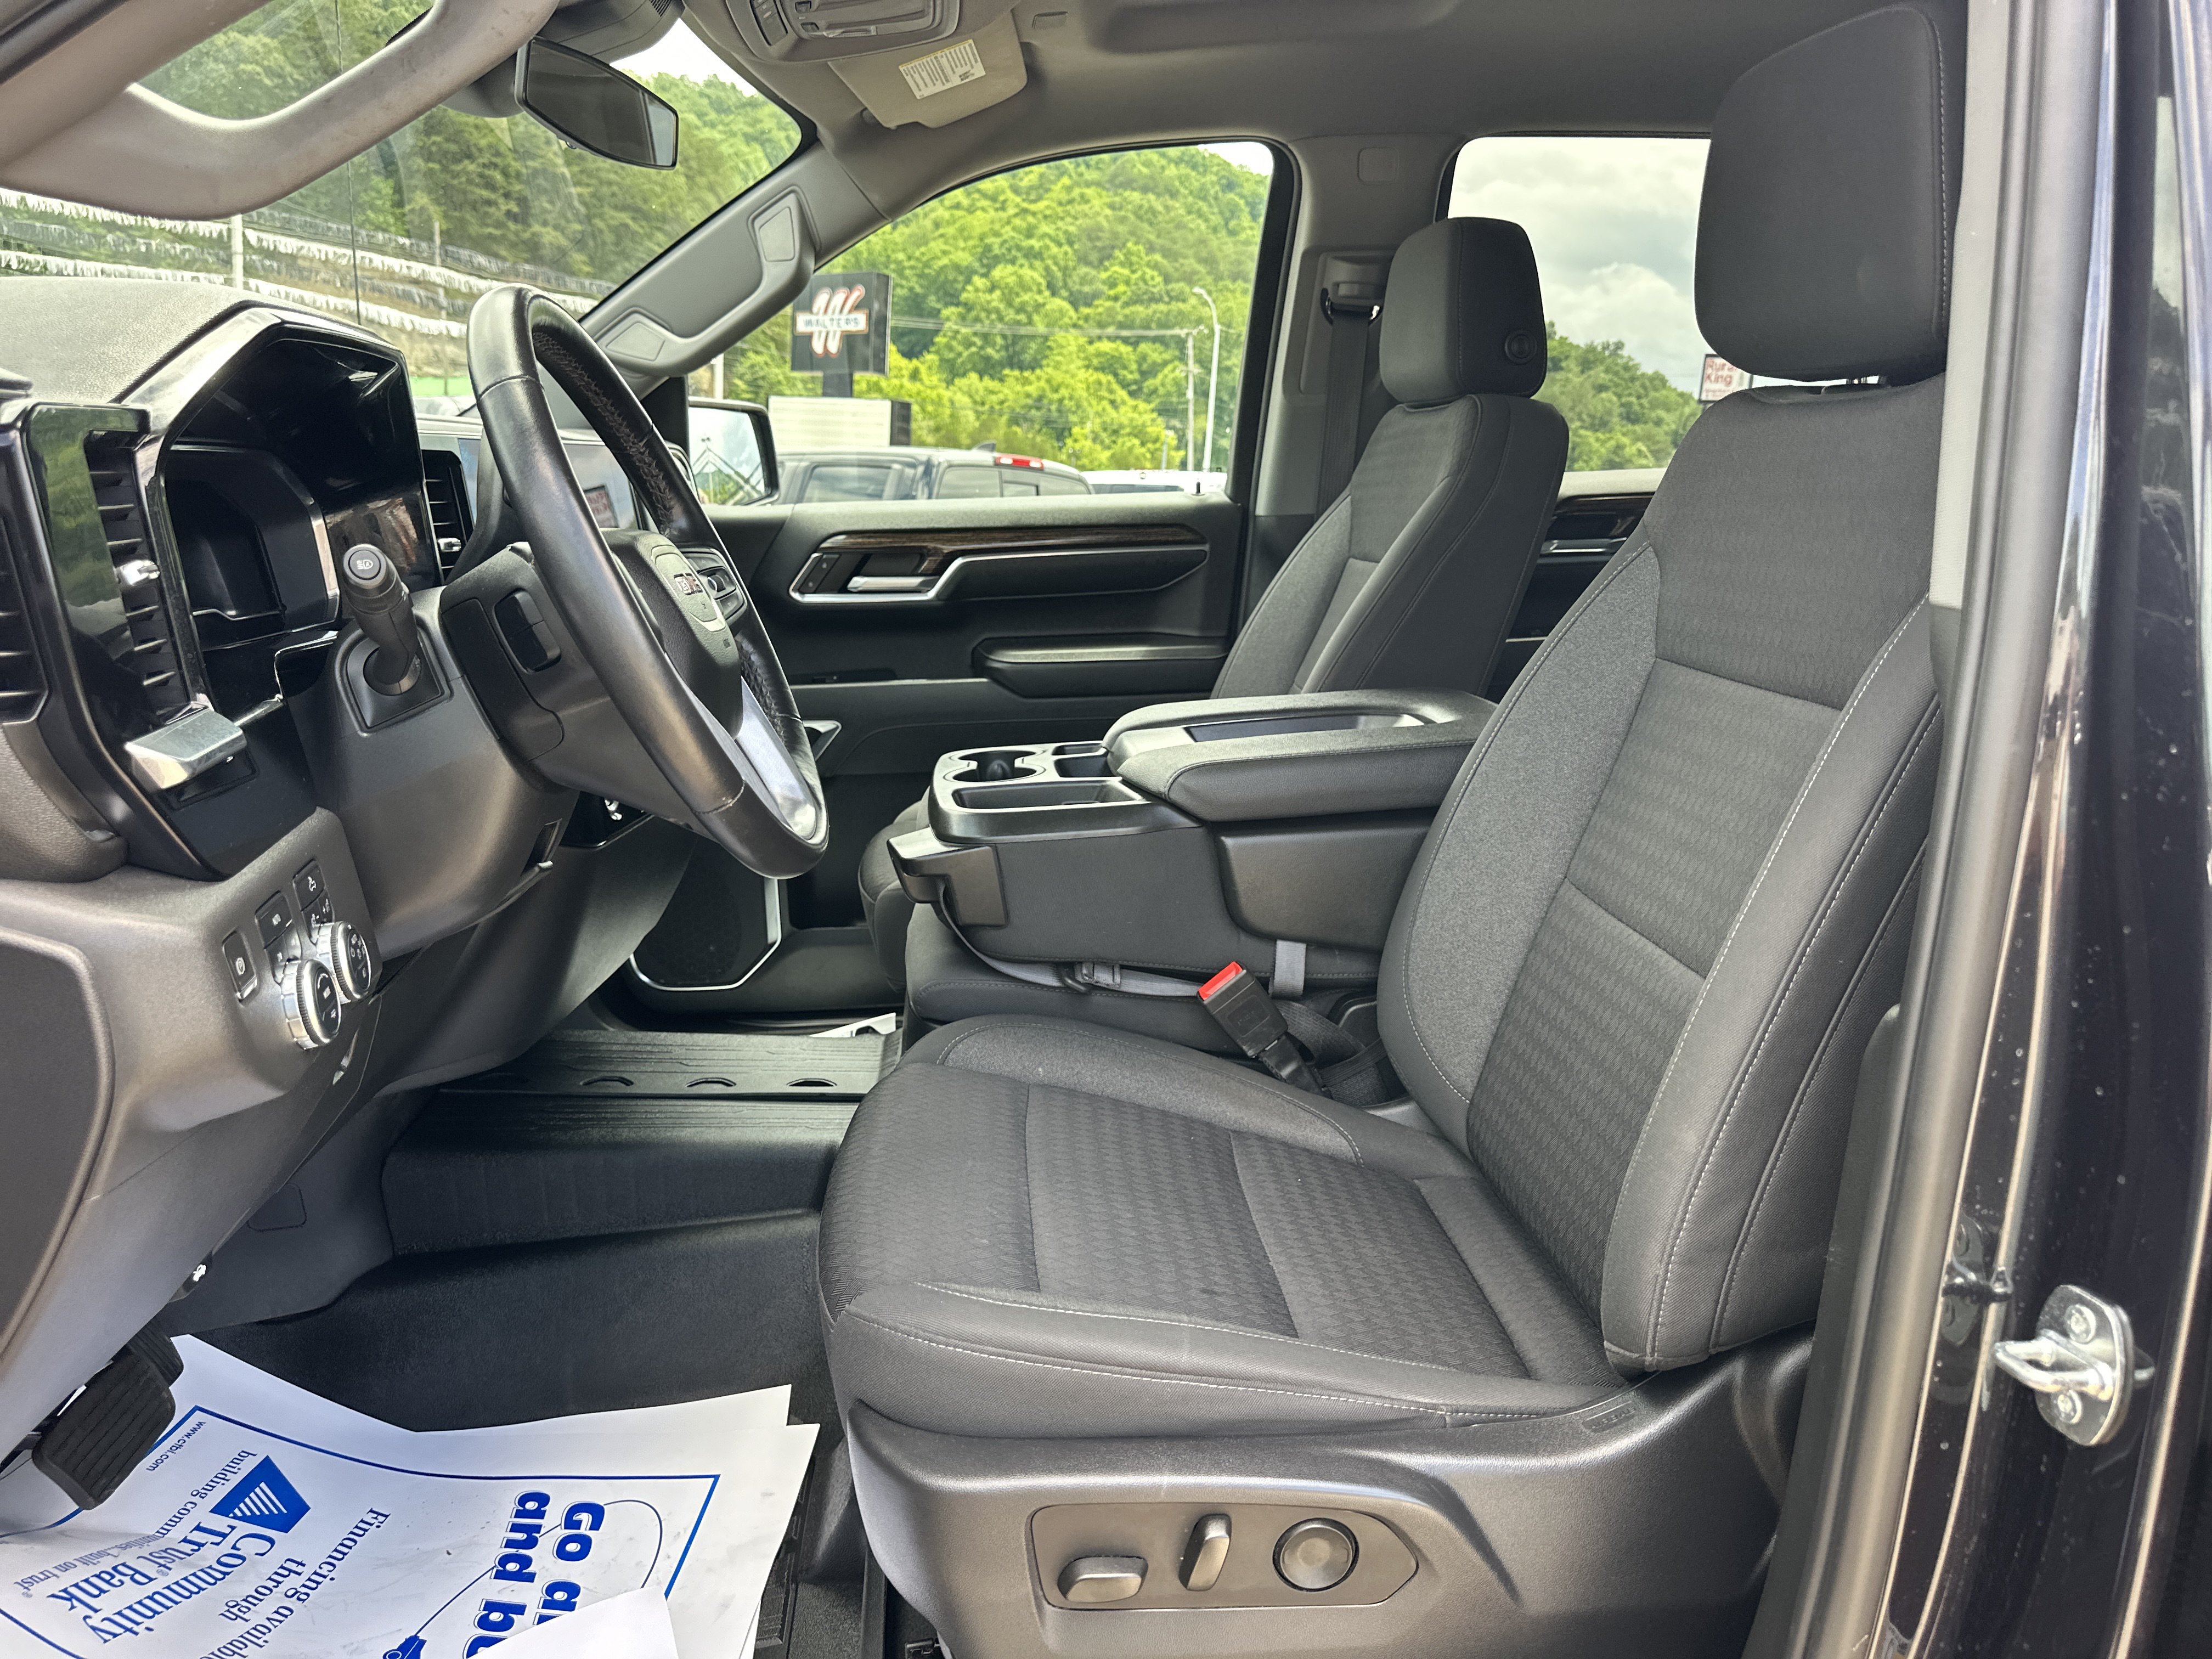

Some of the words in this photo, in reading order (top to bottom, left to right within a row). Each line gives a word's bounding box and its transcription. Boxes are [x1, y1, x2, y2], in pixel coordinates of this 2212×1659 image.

[1703, 373, 1733, 387] King
[1706, 358, 1737, 372] Rura
[146, 1421, 206, 1471] www.ctbi.com
[190, 1449, 258, 1499] building
[284, 1508, 391, 1604] Financing
[489, 1490, 551, 1583] and
[552, 1500, 605, 1562] Go
[46, 1561, 159, 1613] Bank
[52, 1561, 77, 1572] on
[82, 1532, 276, 1644] Community
[218, 1558, 307, 1623] through
